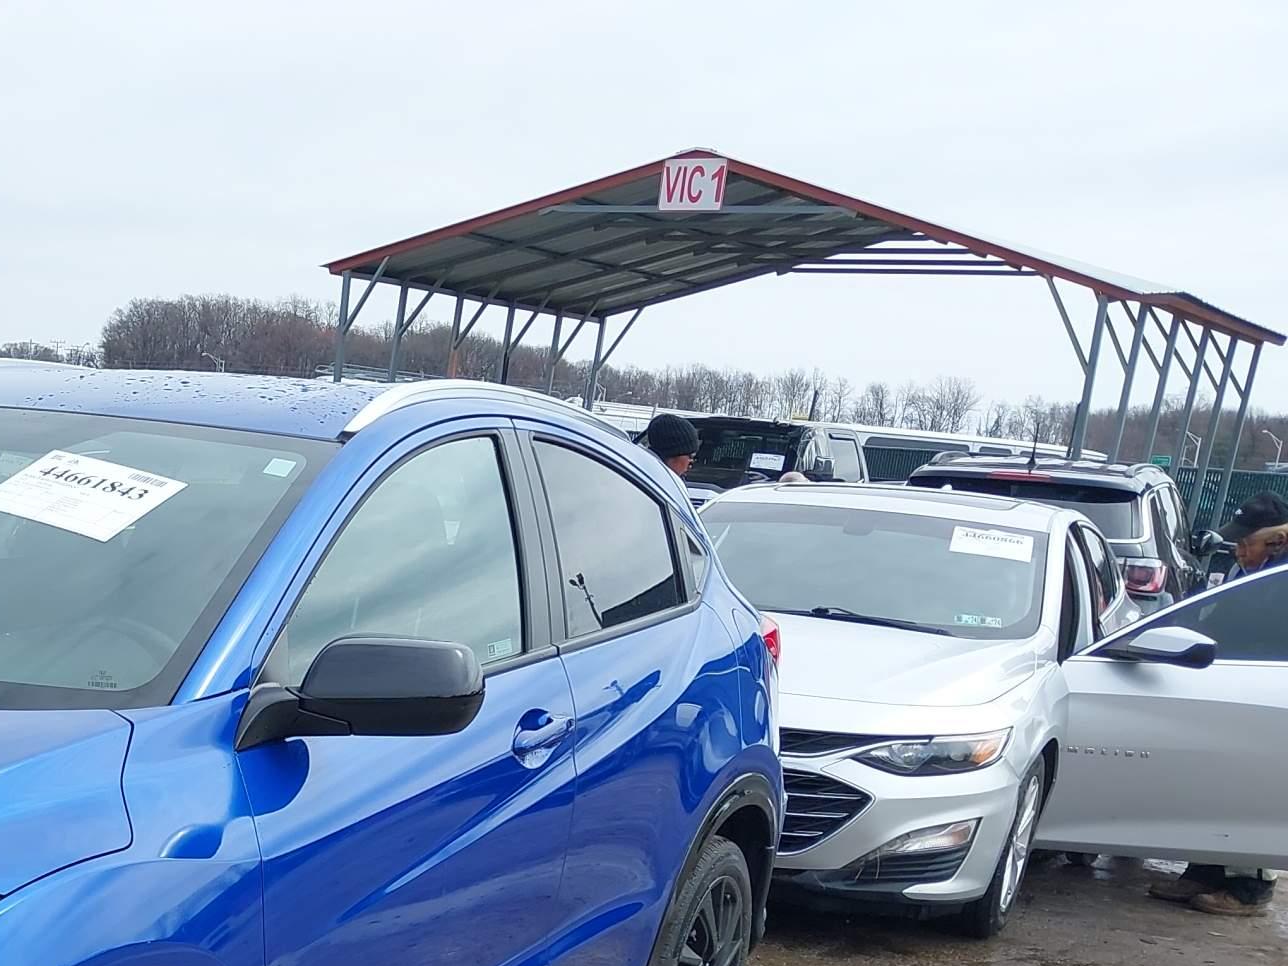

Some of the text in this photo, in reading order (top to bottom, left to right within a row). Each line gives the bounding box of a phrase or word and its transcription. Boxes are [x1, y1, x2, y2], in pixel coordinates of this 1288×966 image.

[665, 165, 726, 204] VIC 1
[39, 465, 150, 501] 44661843
